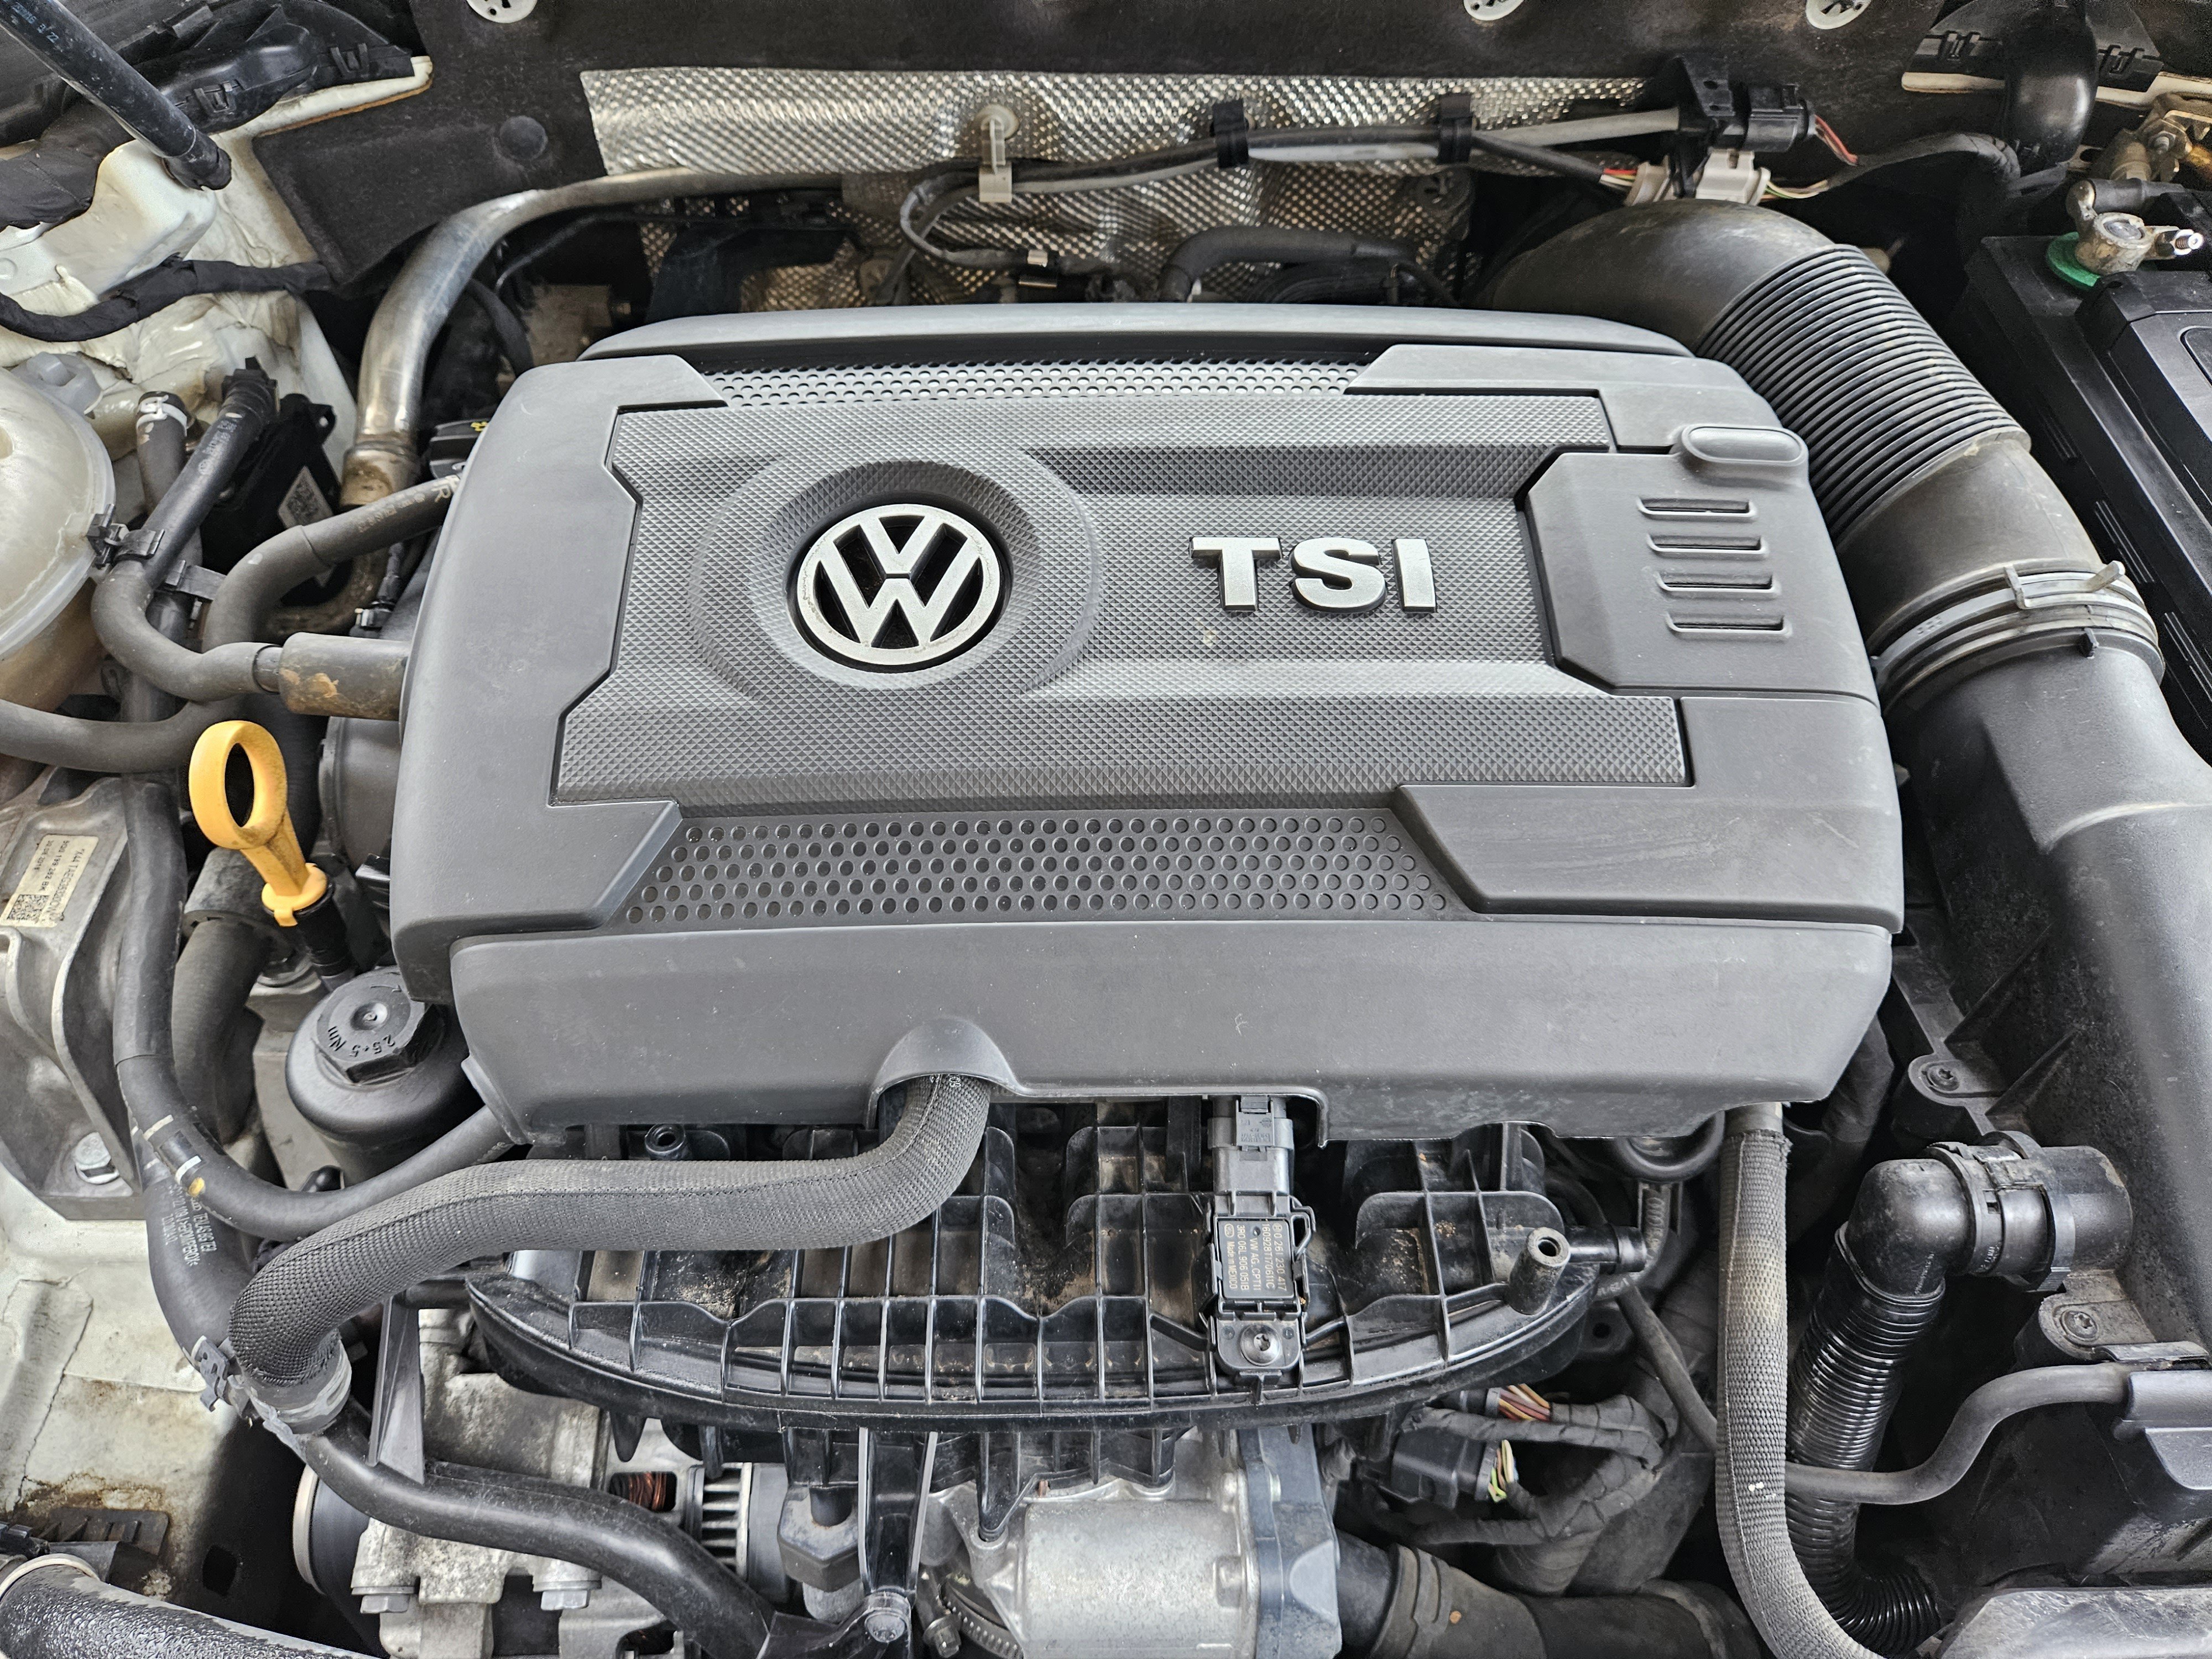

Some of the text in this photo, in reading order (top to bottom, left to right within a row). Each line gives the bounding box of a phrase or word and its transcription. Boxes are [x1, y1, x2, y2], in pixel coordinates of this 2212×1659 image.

[1189, 536, 1437, 614] TSI
[797, 504, 1000, 665] VW
[1227, 1241, 1235, 1257] Made
[1238, 1240, 1246, 1255] 06L
[1250, 1238, 1258, 1251] VW
[1274, 1240, 1284, 1255] 261
[1239, 1256, 1248, 1271] 906
[1275, 1258, 1285, 1274] 230
[1228, 1265, 1238, 1289] MEXICO
[1240, 1272, 1249, 1291] 051B
[1277, 1276, 1287, 1291] 417
